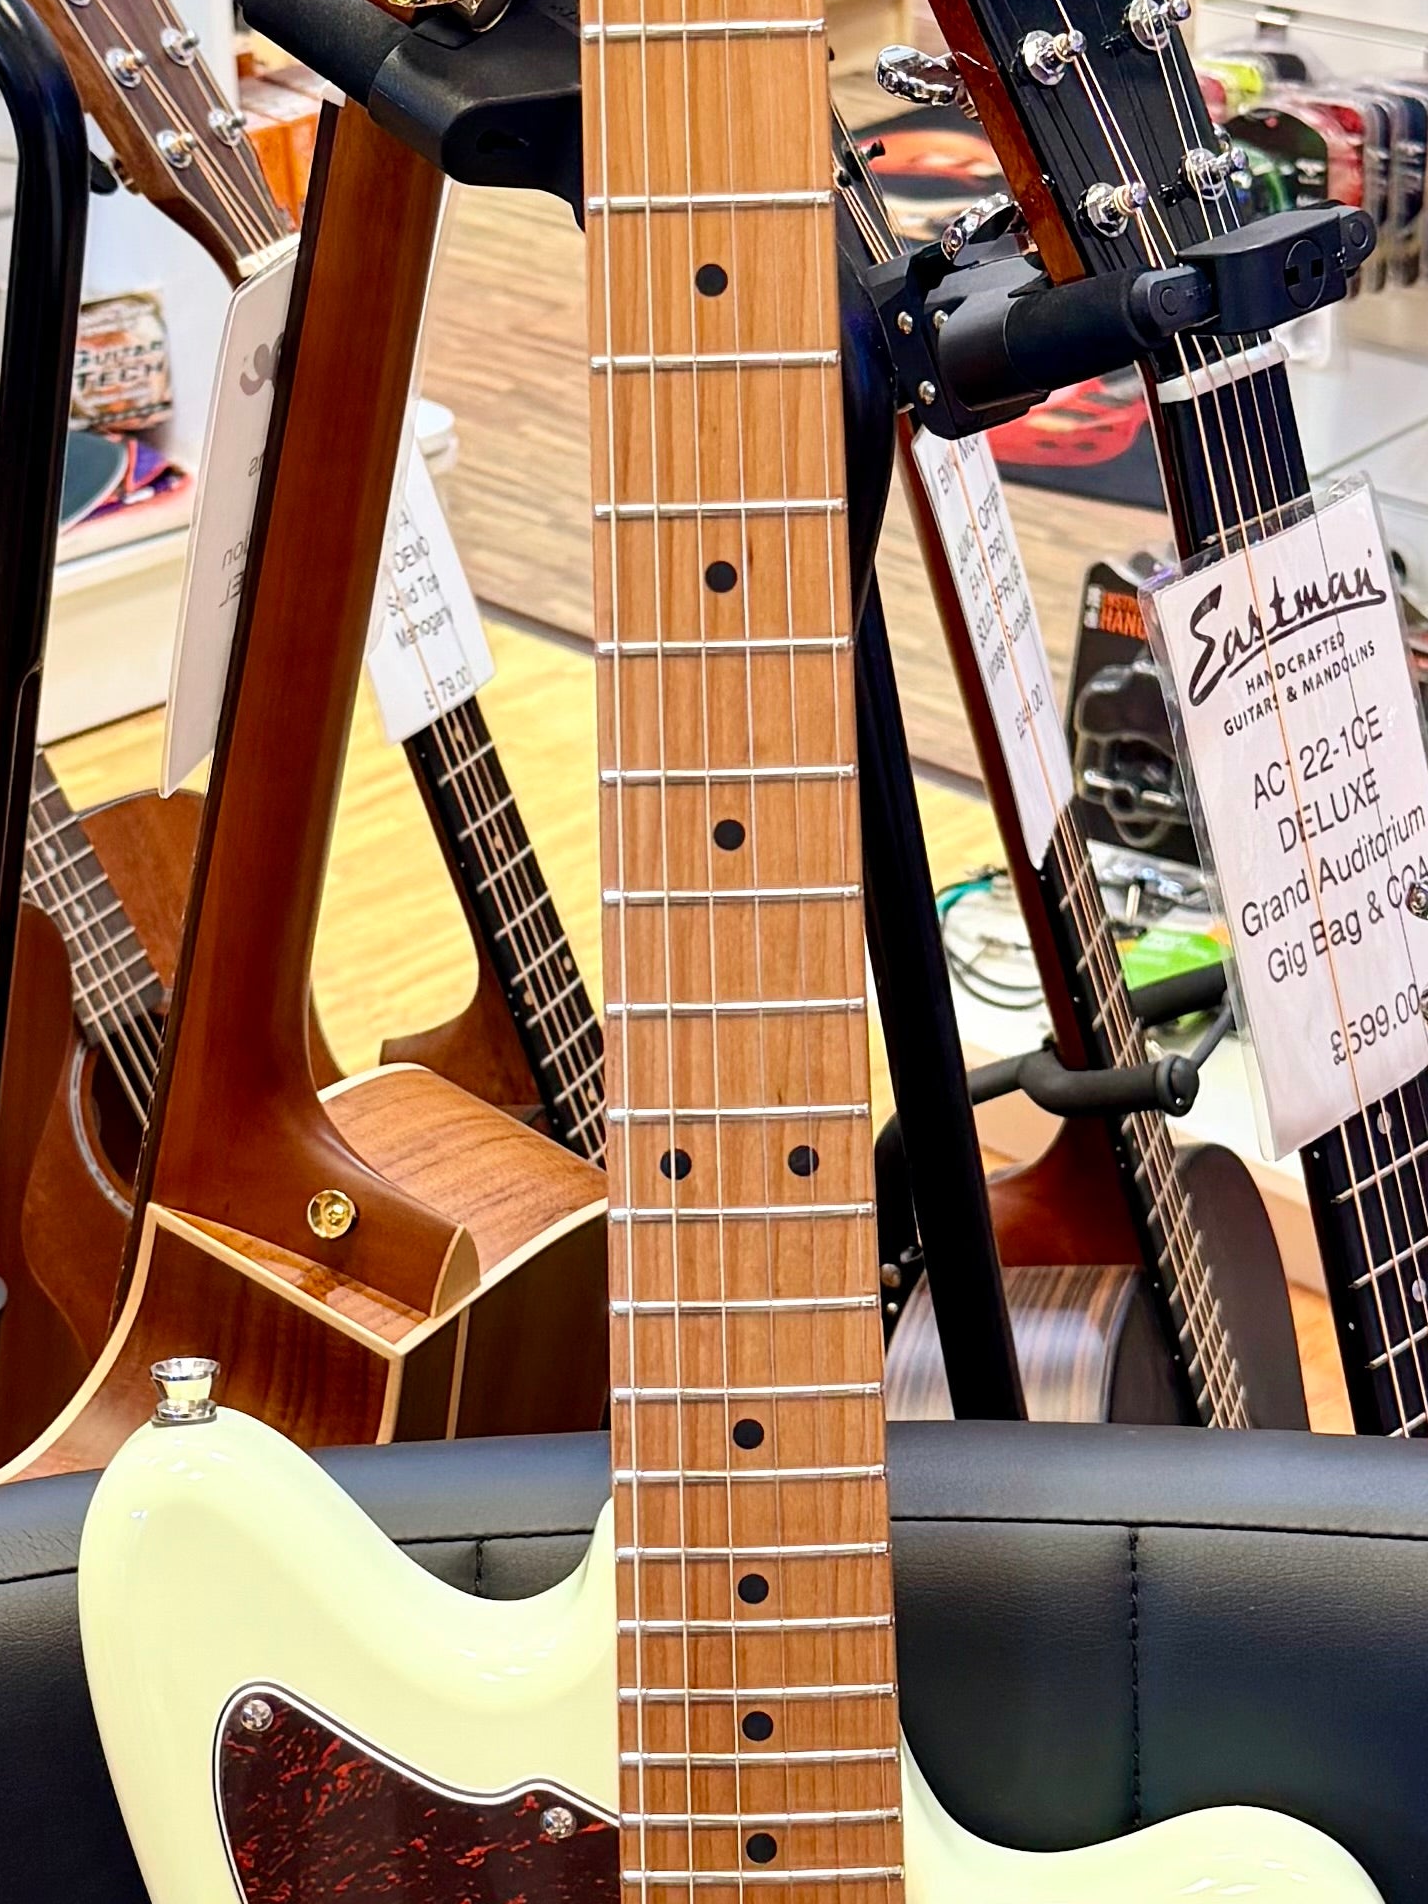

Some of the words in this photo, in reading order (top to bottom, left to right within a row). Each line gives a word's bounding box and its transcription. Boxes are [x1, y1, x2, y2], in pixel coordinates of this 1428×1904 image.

[72, 359, 166, 392] TECH
[394, 533, 432, 574] DEMO
[1187, 549, 1389, 708] Eastman
[1244, 631, 1347, 694] HANDCRAFTED
[423, 665, 471, 712] £79.00
[1222, 695, 1279, 738] GUITARS
[1285, 683, 1299, 704] &
[1300, 639, 1377, 697] MANDOLINS
[1251, 703, 1385, 810] AC22-1CE
[1276, 766, 1382, 854] DELUXE
[1240, 878, 1313, 942] Grand
[1316, 803, 1428, 896] Auditorium
[1266, 936, 1309, 985] Gig
[1314, 911, 1364, 963] Bag
[1366, 889, 1385, 925] &
